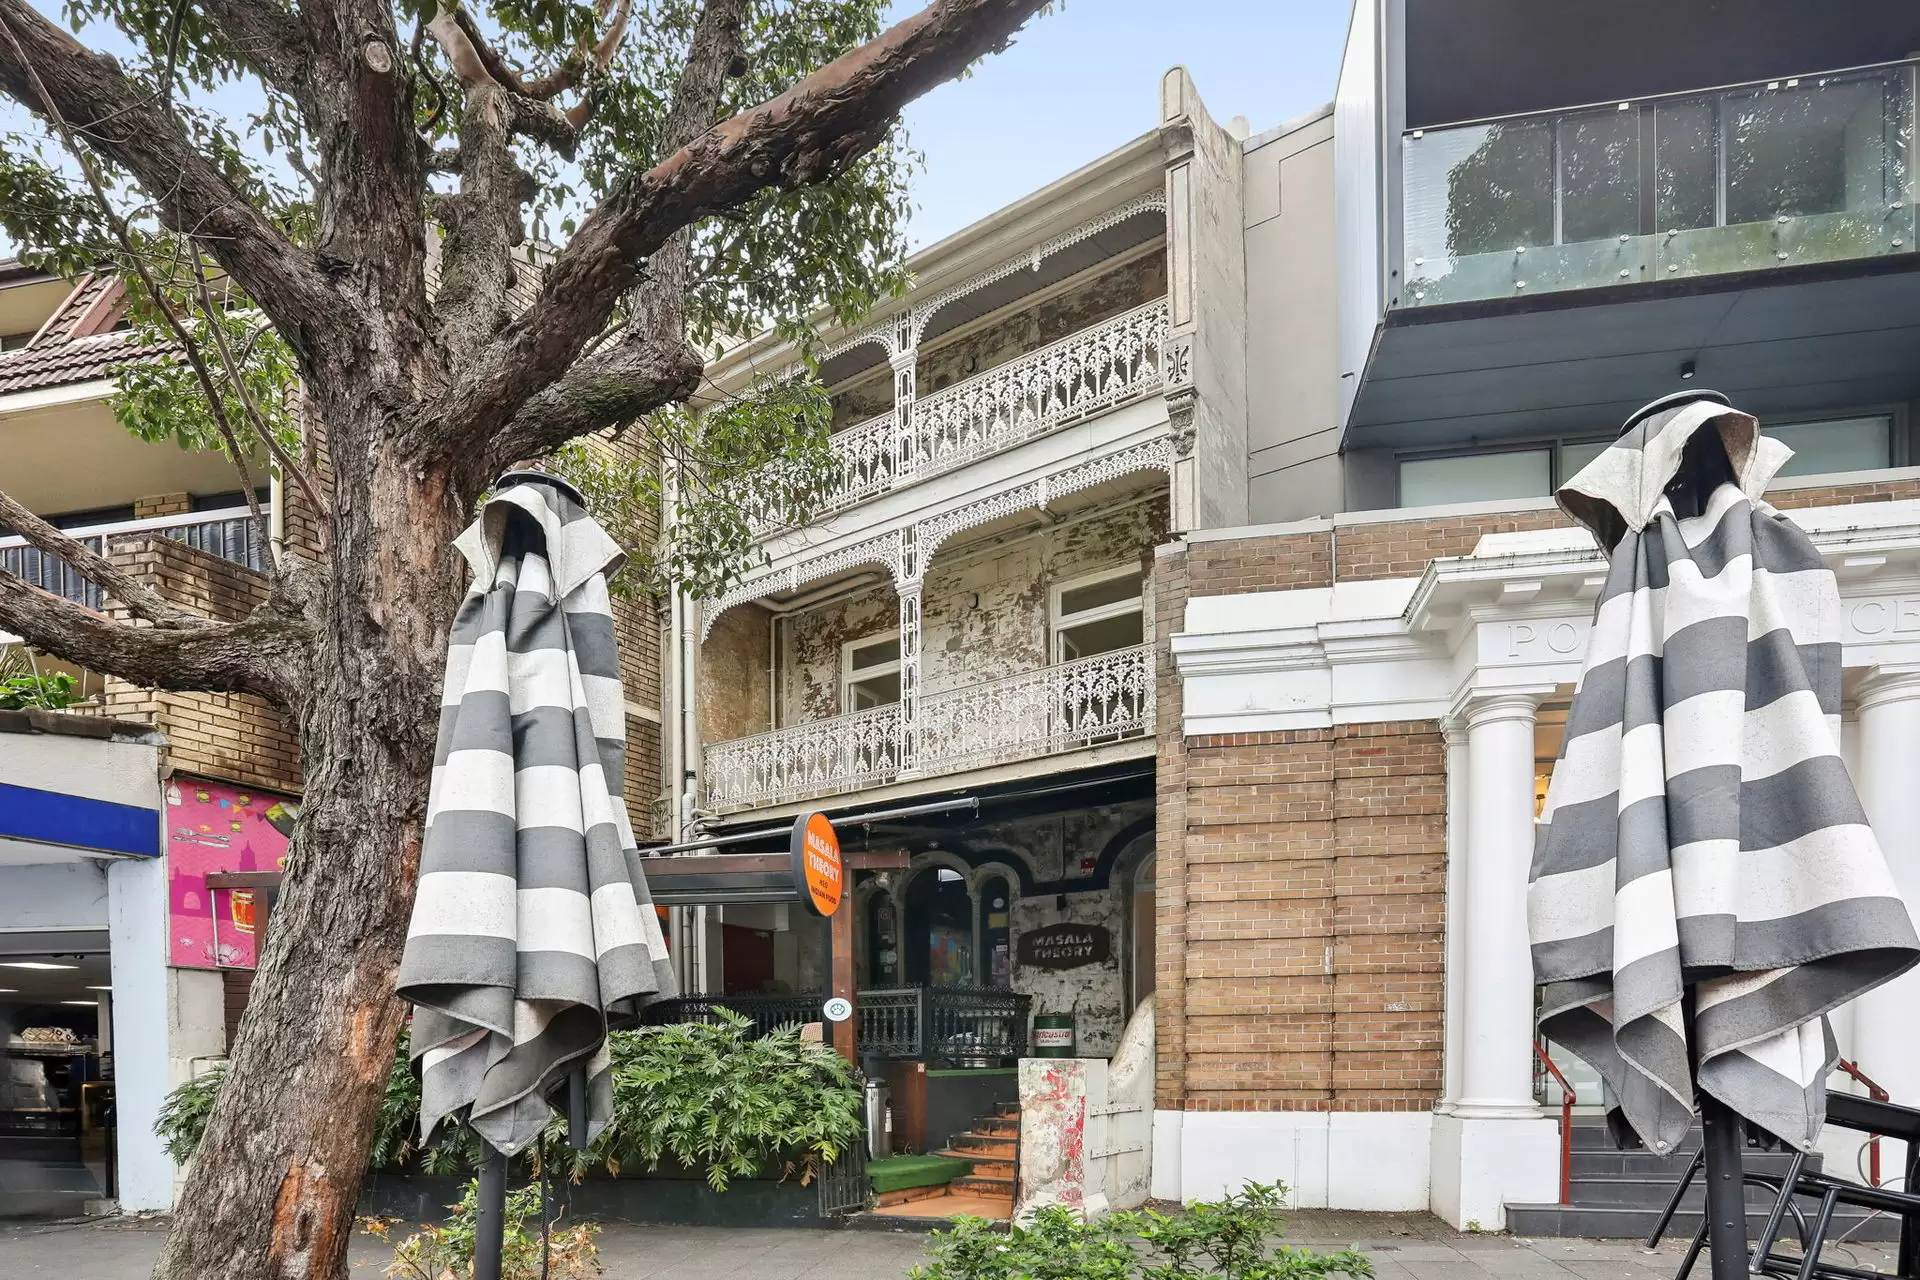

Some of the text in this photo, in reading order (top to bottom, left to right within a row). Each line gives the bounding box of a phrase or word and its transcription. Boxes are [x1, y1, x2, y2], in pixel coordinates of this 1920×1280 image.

[807, 830, 840, 864] MASALA
[807, 850, 840, 882] THEORY
[1032, 932, 1094, 947] MASALA
[1032, 945, 1094, 960] THEORY
